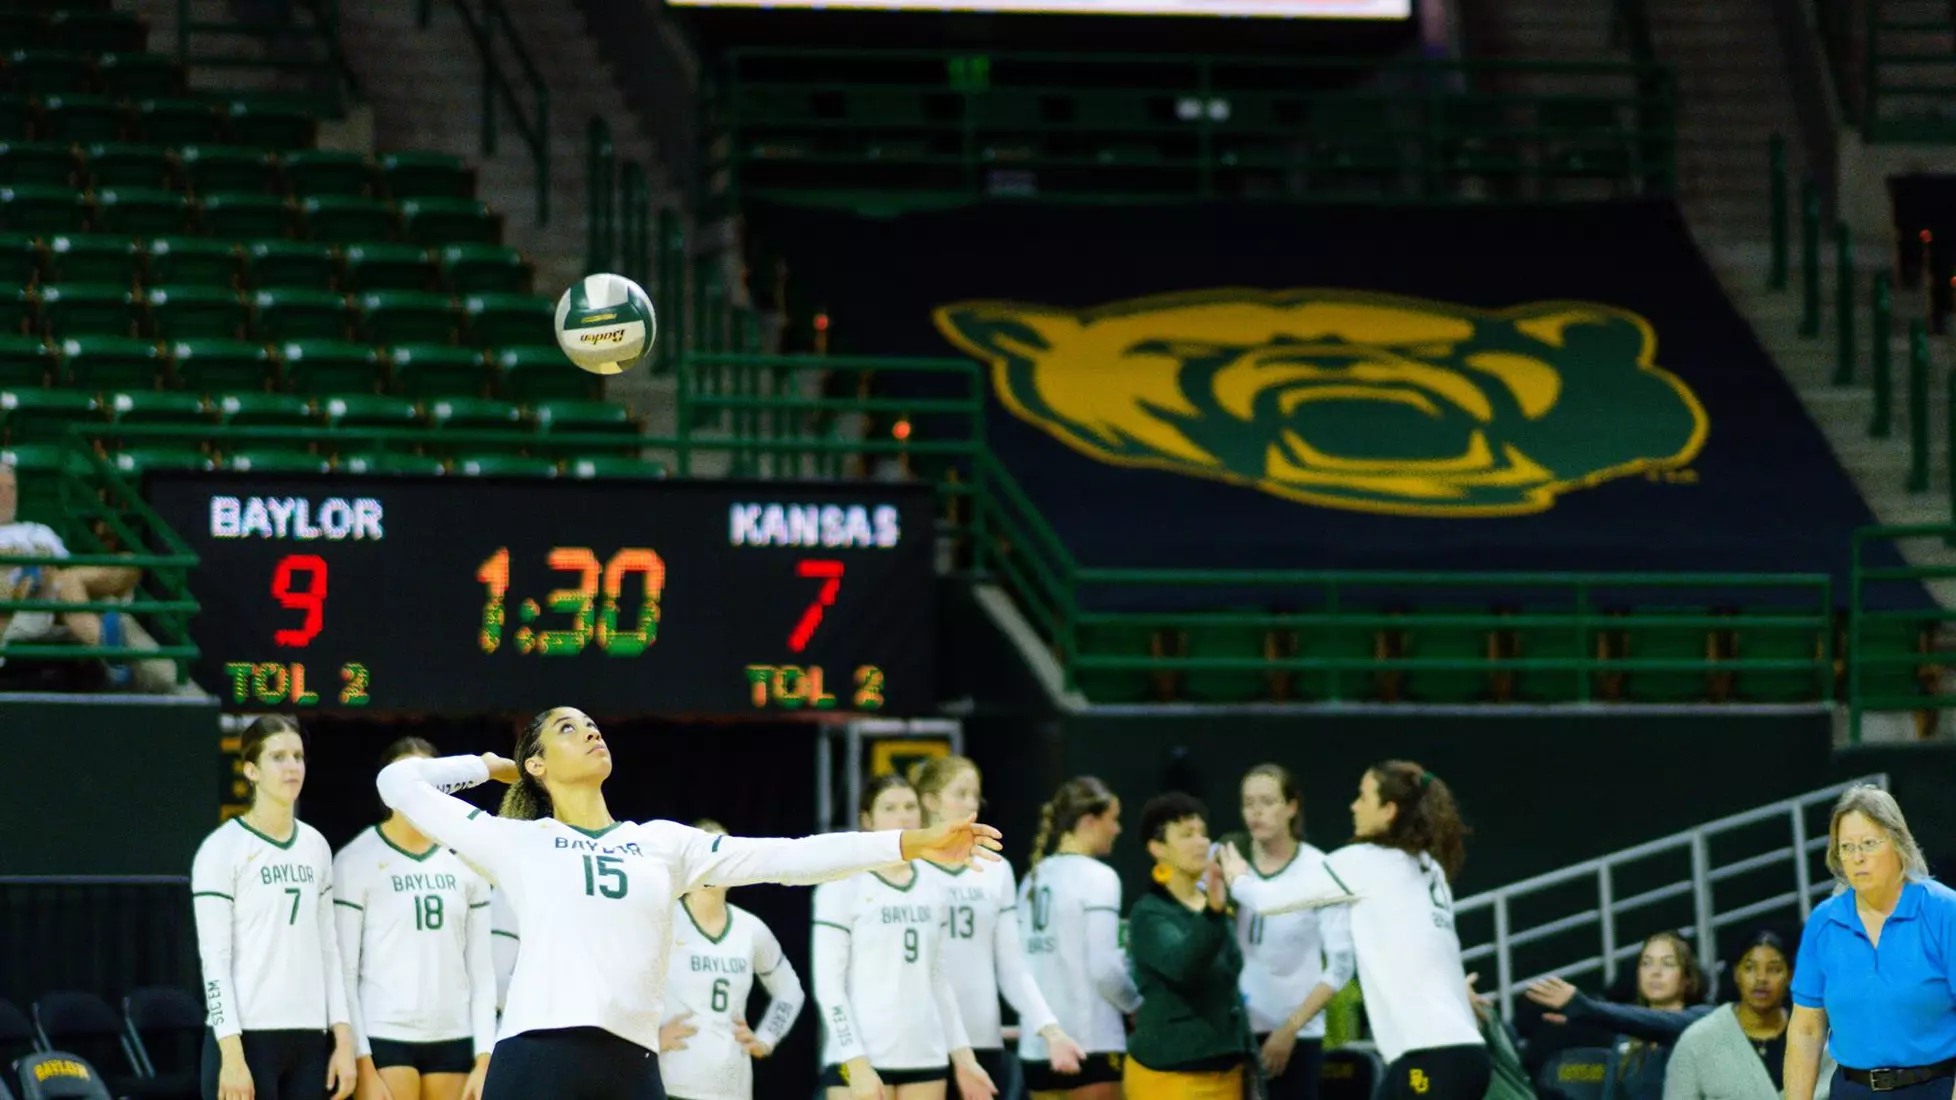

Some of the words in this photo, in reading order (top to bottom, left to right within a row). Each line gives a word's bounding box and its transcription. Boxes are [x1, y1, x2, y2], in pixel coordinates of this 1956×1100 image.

[580, 329, 625, 345] Baden
[211, 497, 383, 541] BAYLOR
[729, 502, 900, 547] KANSAS
[271, 554, 328, 646] 9
[477, 547, 665, 658] 1:30
[787, 559, 845, 652] 7
[225, 662, 320, 704] TOL
[340, 662, 370, 704] 2
[744, 664, 837, 709] TOL
[853, 664, 885, 708] 2
[260, 864, 315, 885] BAYLOR
[391, 873, 457, 893] BAYLOR
[582, 854, 628, 900] 15
[284, 887, 301, 926] 7
[414, 894, 443, 931] 18
[880, 905, 932, 923] BAYLOR
[949, 905, 974, 939] 13
[904, 927, 918, 963] 9
[690, 955, 747, 974] BAYLOR
[711, 978, 730, 1013] 6
